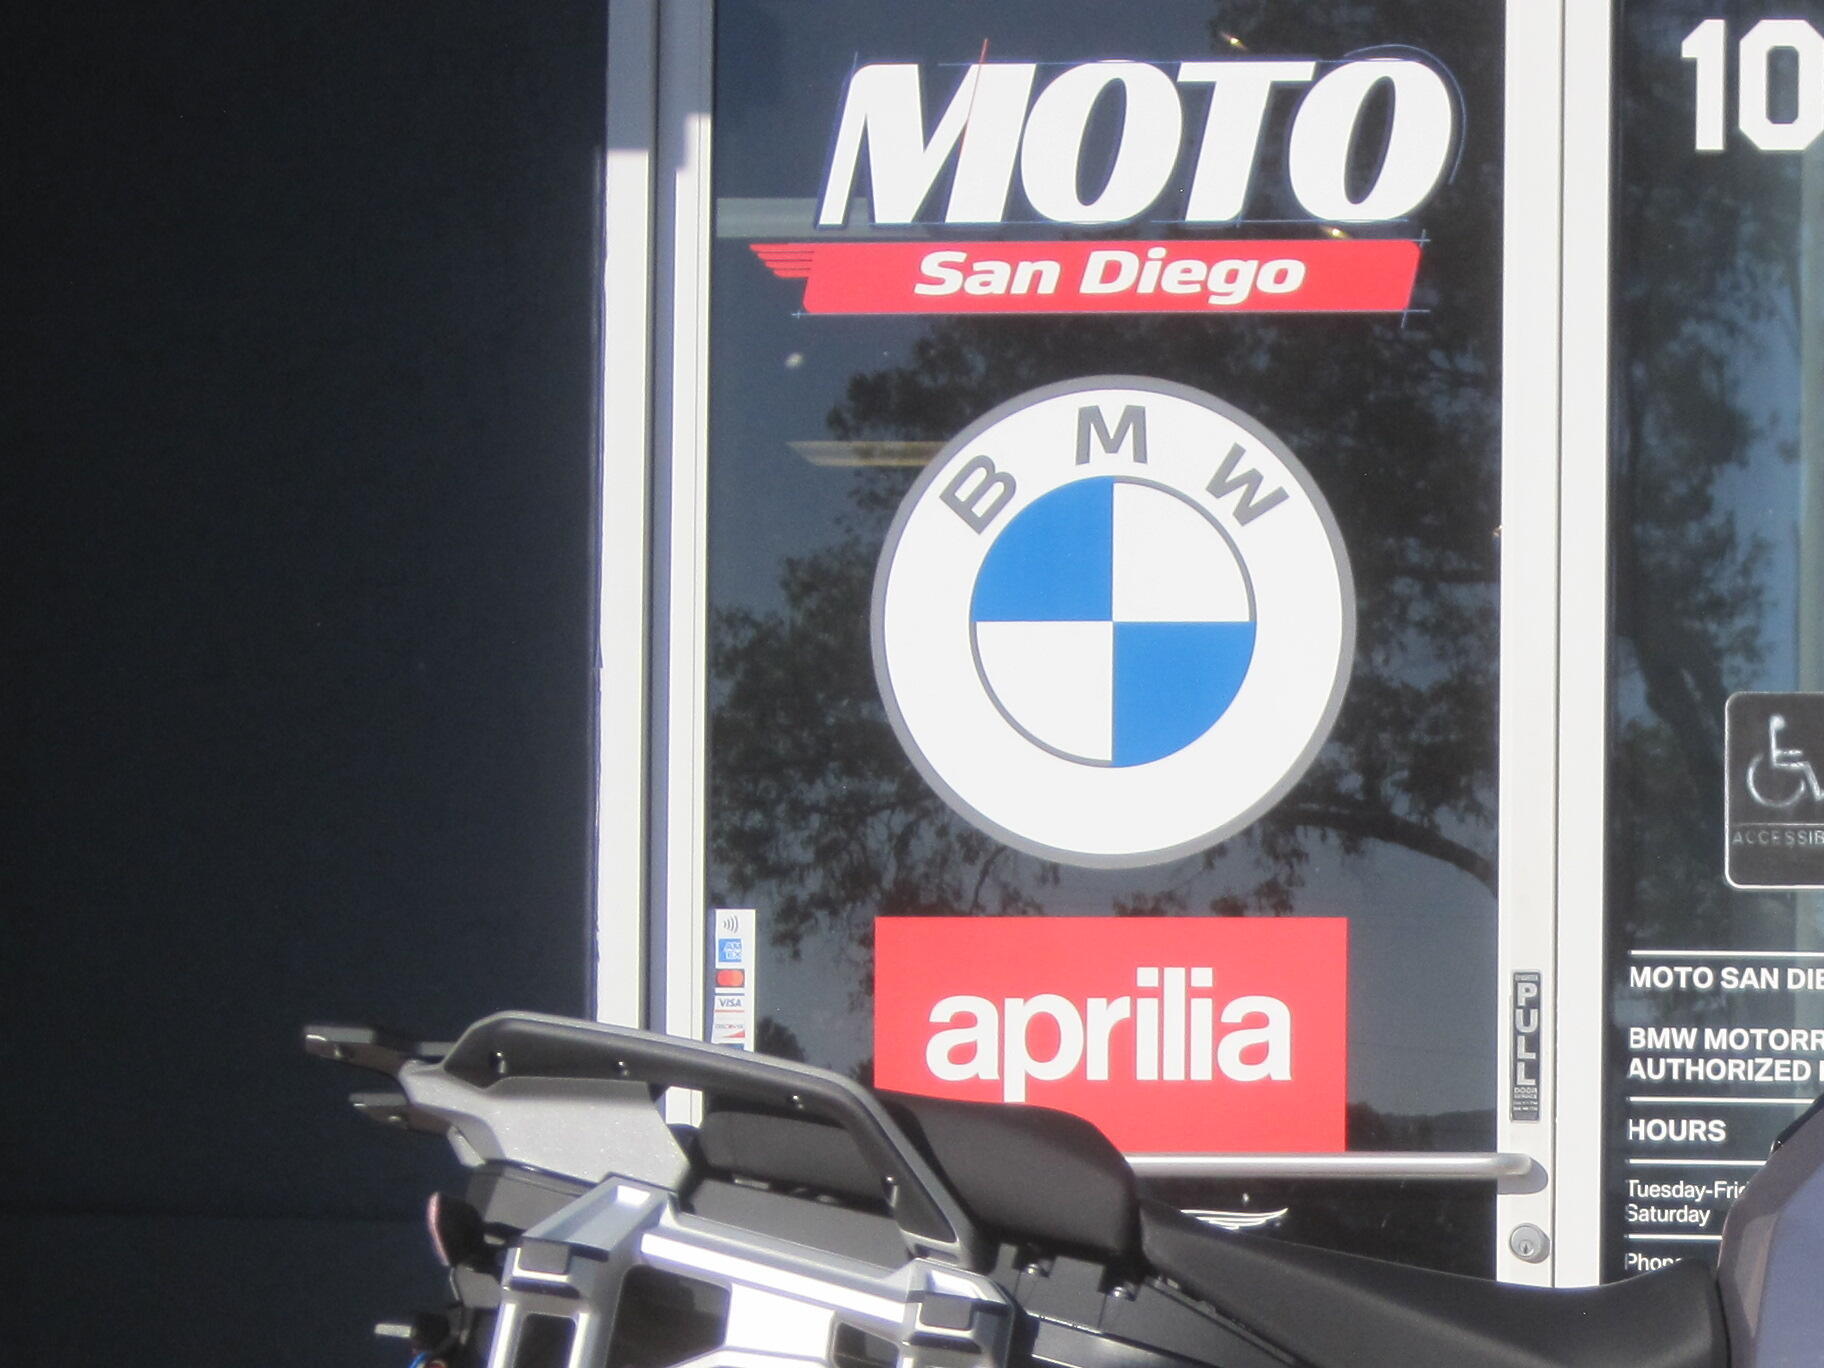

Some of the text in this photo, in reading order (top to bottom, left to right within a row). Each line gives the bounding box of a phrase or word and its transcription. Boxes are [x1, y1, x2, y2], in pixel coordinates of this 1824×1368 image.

[818, 58, 1452, 225] MOTO
[913, 247, 1306, 305] San Diego
[939, 404, 1290, 535] BMW
[1629, 966, 1714, 989] MOTO
[1720, 966, 1779, 990] SAN
[719, 998, 742, 1007] VISA
[925, 966, 1293, 1103] aprilia
[1515, 982, 1539, 1086] PULL
[1628, 1027, 1698, 1050] BMW
[1627, 1057, 1811, 1081] AUTHORIZED
[1627, 1119, 1727, 1142] HOURS
[1625, 1203, 1711, 1227] Saturday
